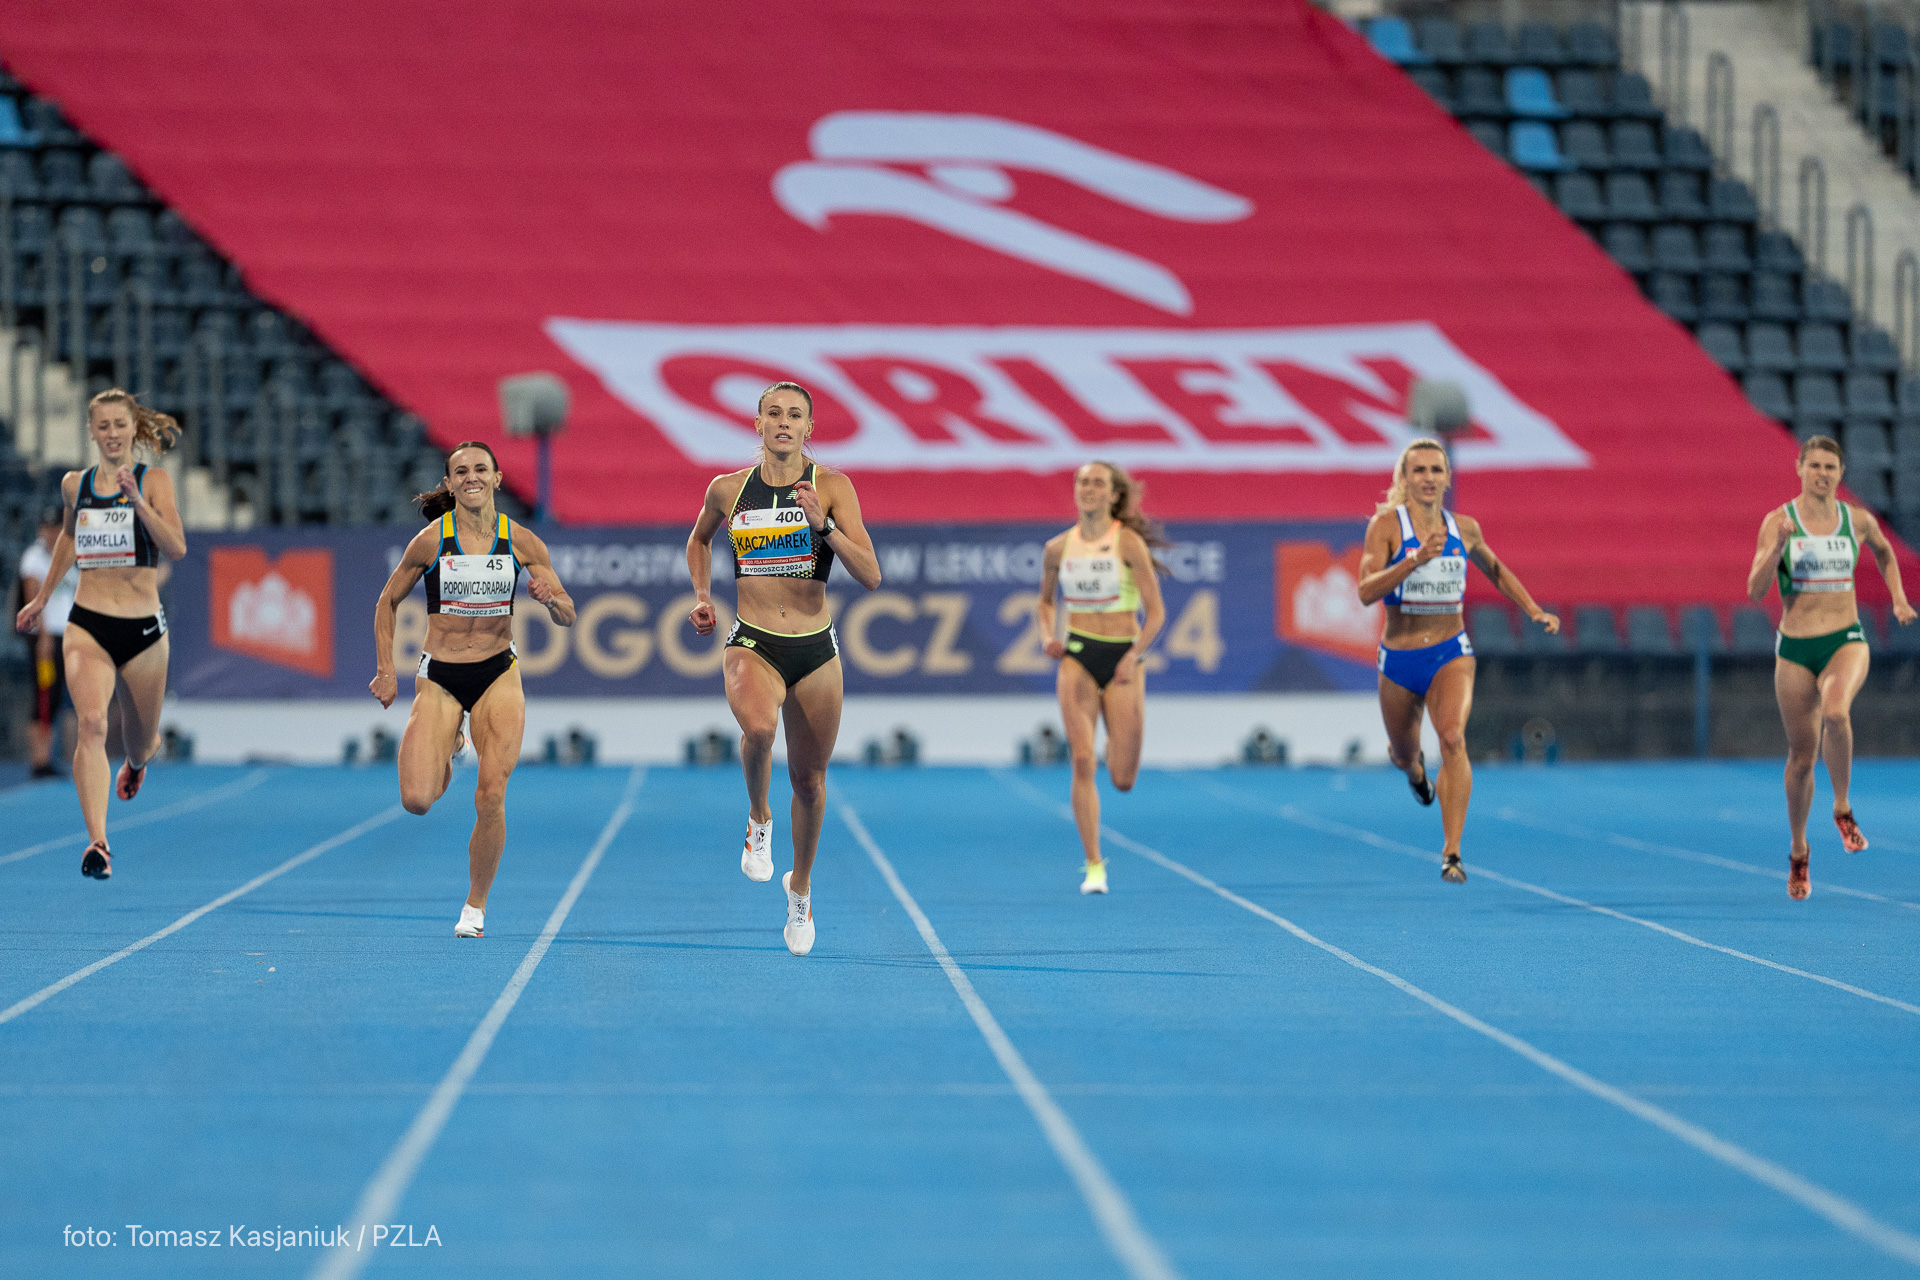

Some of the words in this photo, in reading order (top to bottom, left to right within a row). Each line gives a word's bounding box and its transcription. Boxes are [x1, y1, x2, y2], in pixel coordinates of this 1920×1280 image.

[656, 353, 1494, 444] ORLEN
[104, 512, 127, 523] 709
[775, 511, 803, 523] 400
[78, 534, 127, 548] FORMELLA
[736, 533, 808, 551] KACZMAREK
[486, 559, 503, 571] 45
[444, 581, 511, 595] POPOWICZ-DRAPAŁA
